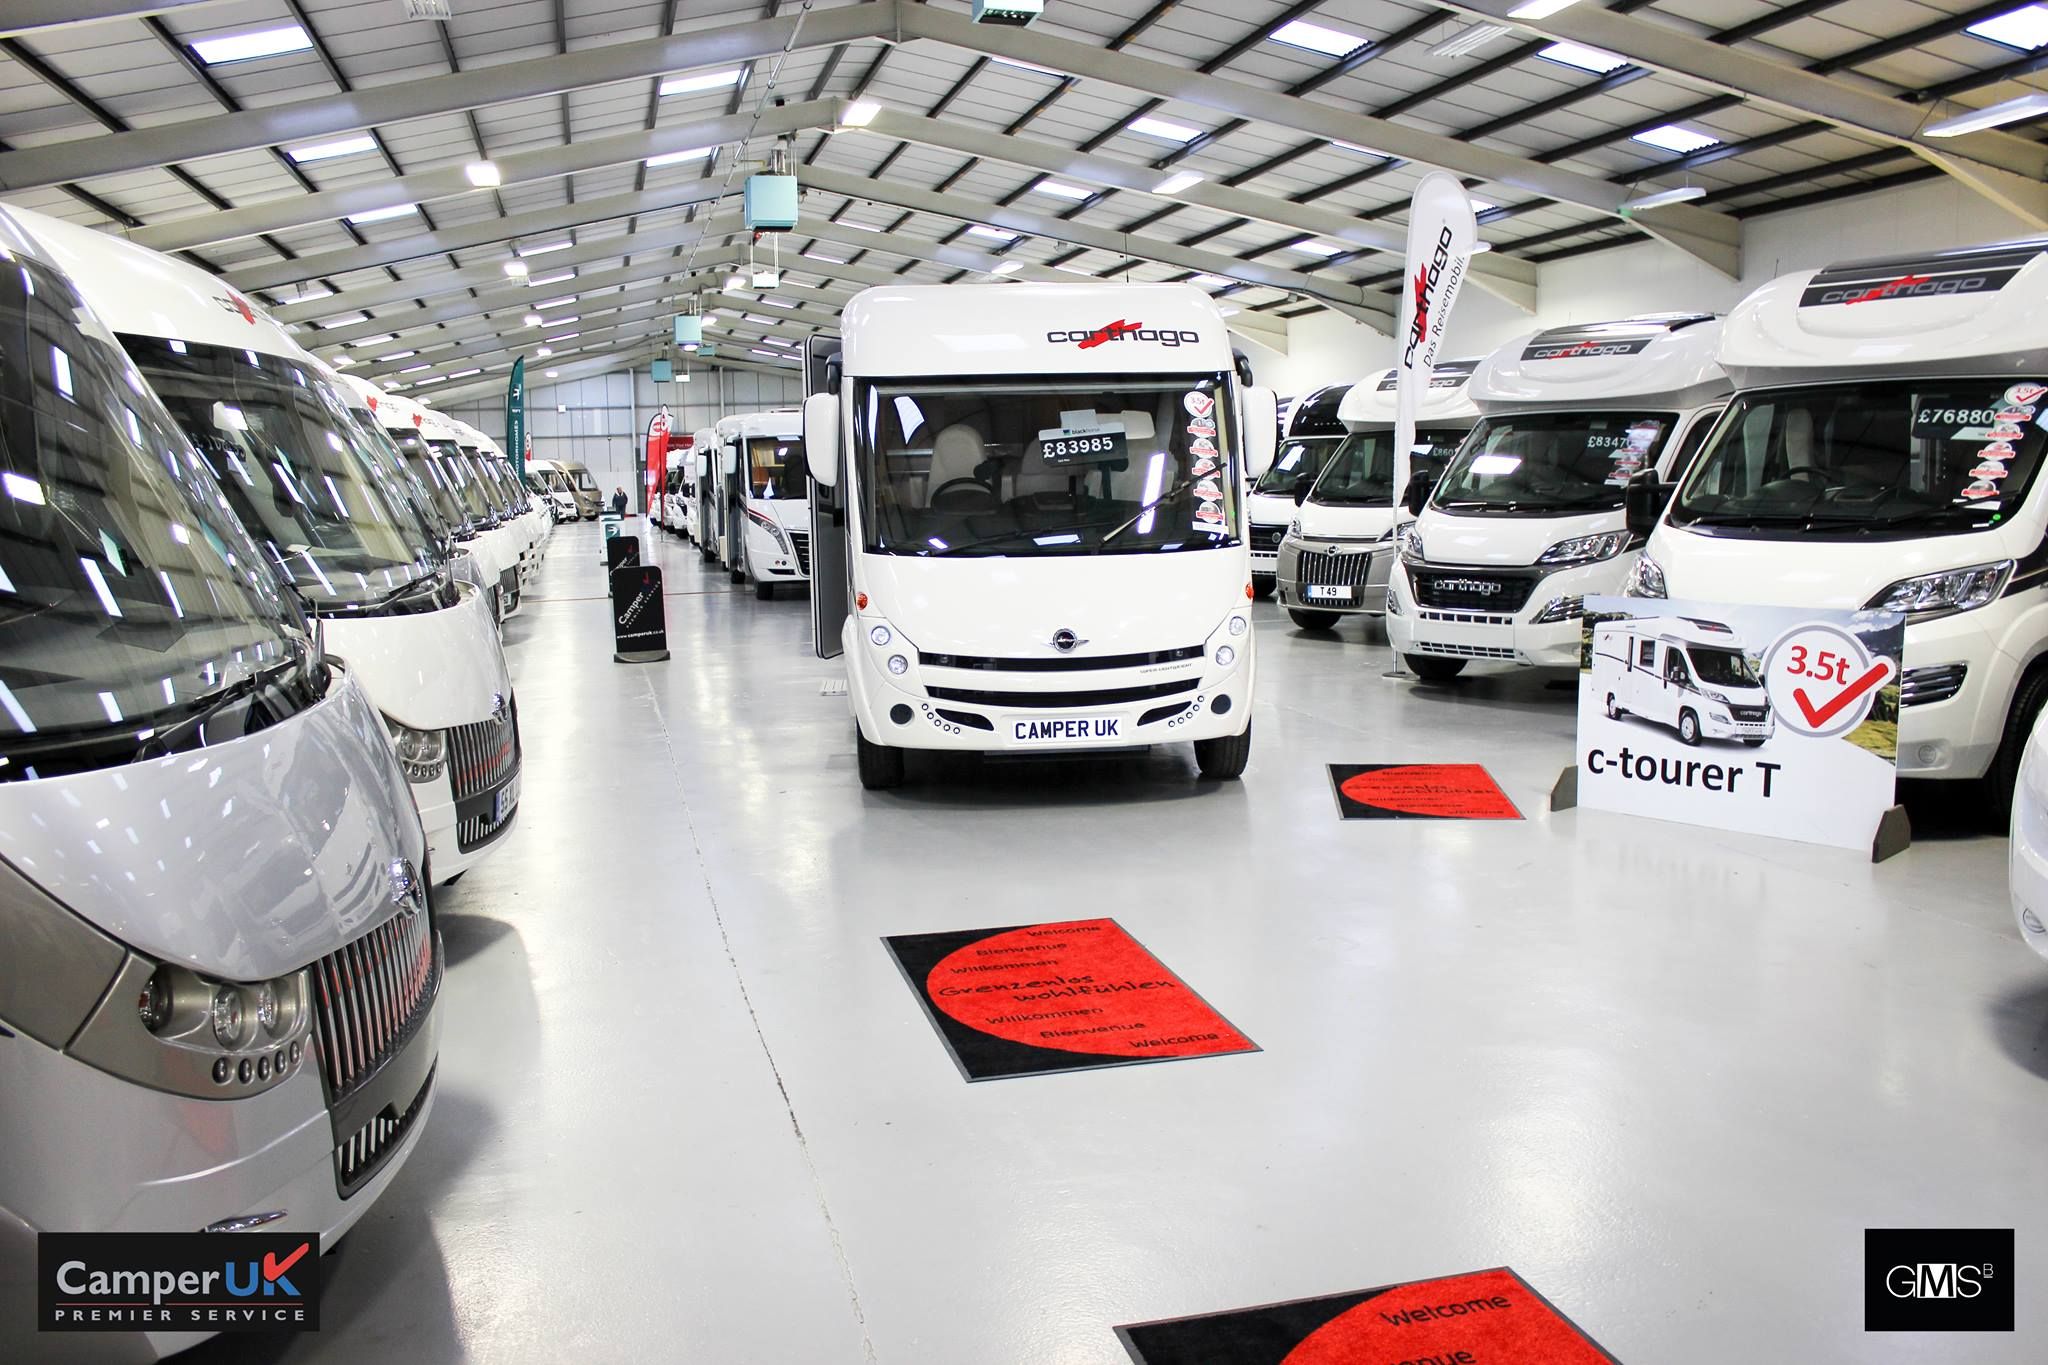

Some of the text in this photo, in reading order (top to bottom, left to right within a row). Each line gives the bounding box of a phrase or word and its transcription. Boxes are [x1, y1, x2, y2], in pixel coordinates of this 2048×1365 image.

[1404, 225, 1453, 370] carthago
[1820, 276, 1987, 303] carthago
[1423, 256, 1466, 368] Das Reisemobil.
[1047, 325, 1200, 347] carthago
[1533, 341, 1632, 359] carthago
[1917, 409, 1995, 425] £76880
[1042, 436, 1114, 459] £83985
[1320, 587, 1337, 596] T 49
[1434, 578, 1502, 595] carthago
[618, 592, 645, 625] Camper
[1786, 645, 1851, 686] 3.5t
[1015, 718, 1120, 740] CAMPER UK
[1587, 746, 1782, 798] c-tourer T
[1026, 924, 1102, 937] Welcome
[976, 941, 1069, 957] Bienvenue
[950, 959, 1060, 975] Willkommen
[938, 973, 1095, 997] Grenzenlos
[1013, 979, 1176, 1003] wohlfühlen
[985, 1006, 1104, 1025] Willkommen
[1039, 1021, 1147, 1039] Bienvenue
[1129, 1032, 1220, 1049] Welcome
[1380, 1290, 1512, 1327] Welcome
